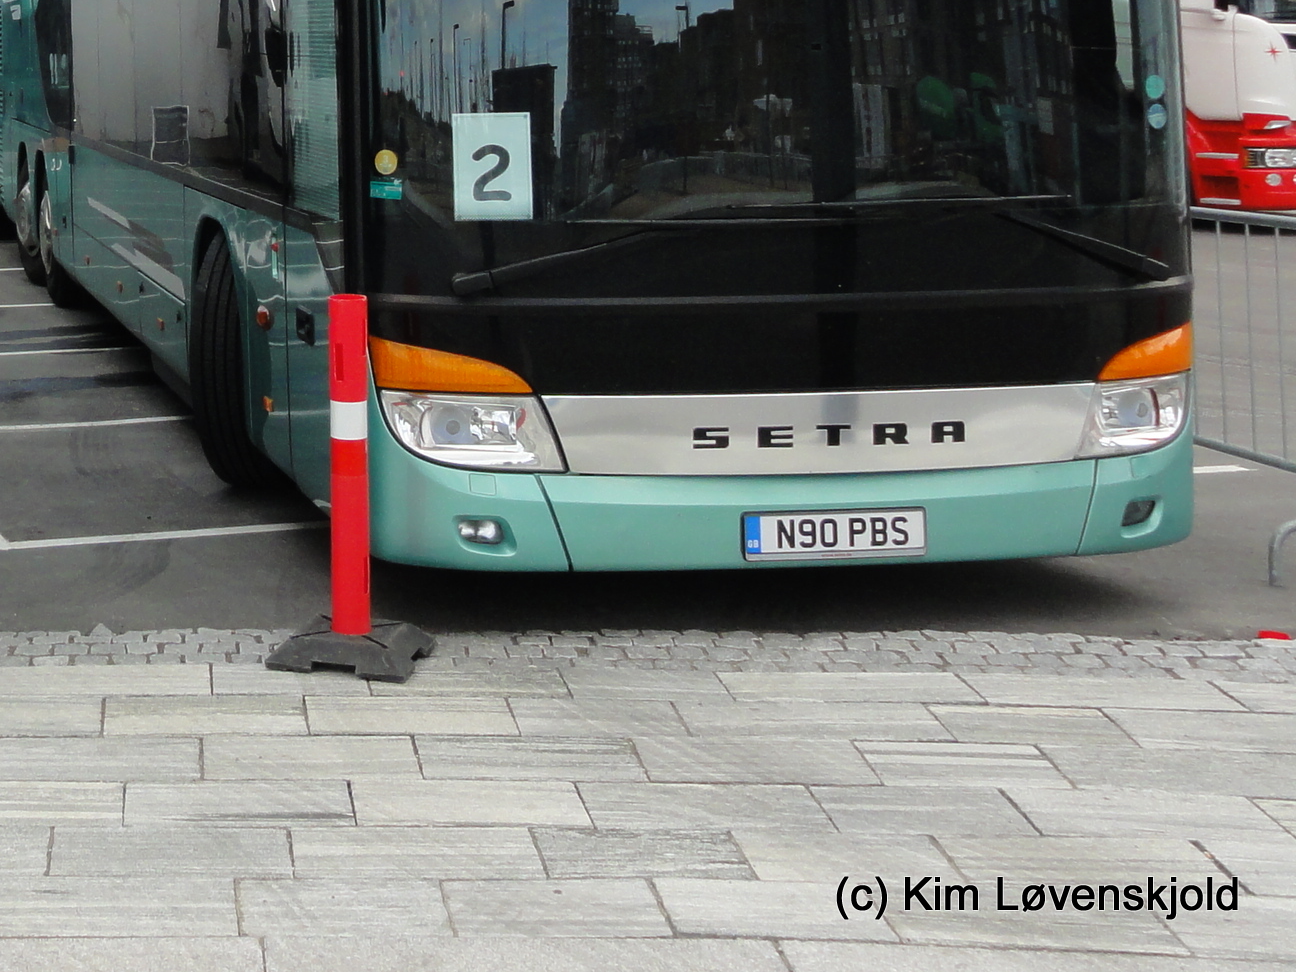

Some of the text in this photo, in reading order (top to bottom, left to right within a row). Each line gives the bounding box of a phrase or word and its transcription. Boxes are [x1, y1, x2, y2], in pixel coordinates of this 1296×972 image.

[471, 144, 513, 202] 2
[692, 420, 966, 449] SETRA
[747, 539, 760, 549] GB
[776, 516, 910, 549] N90 PBS
